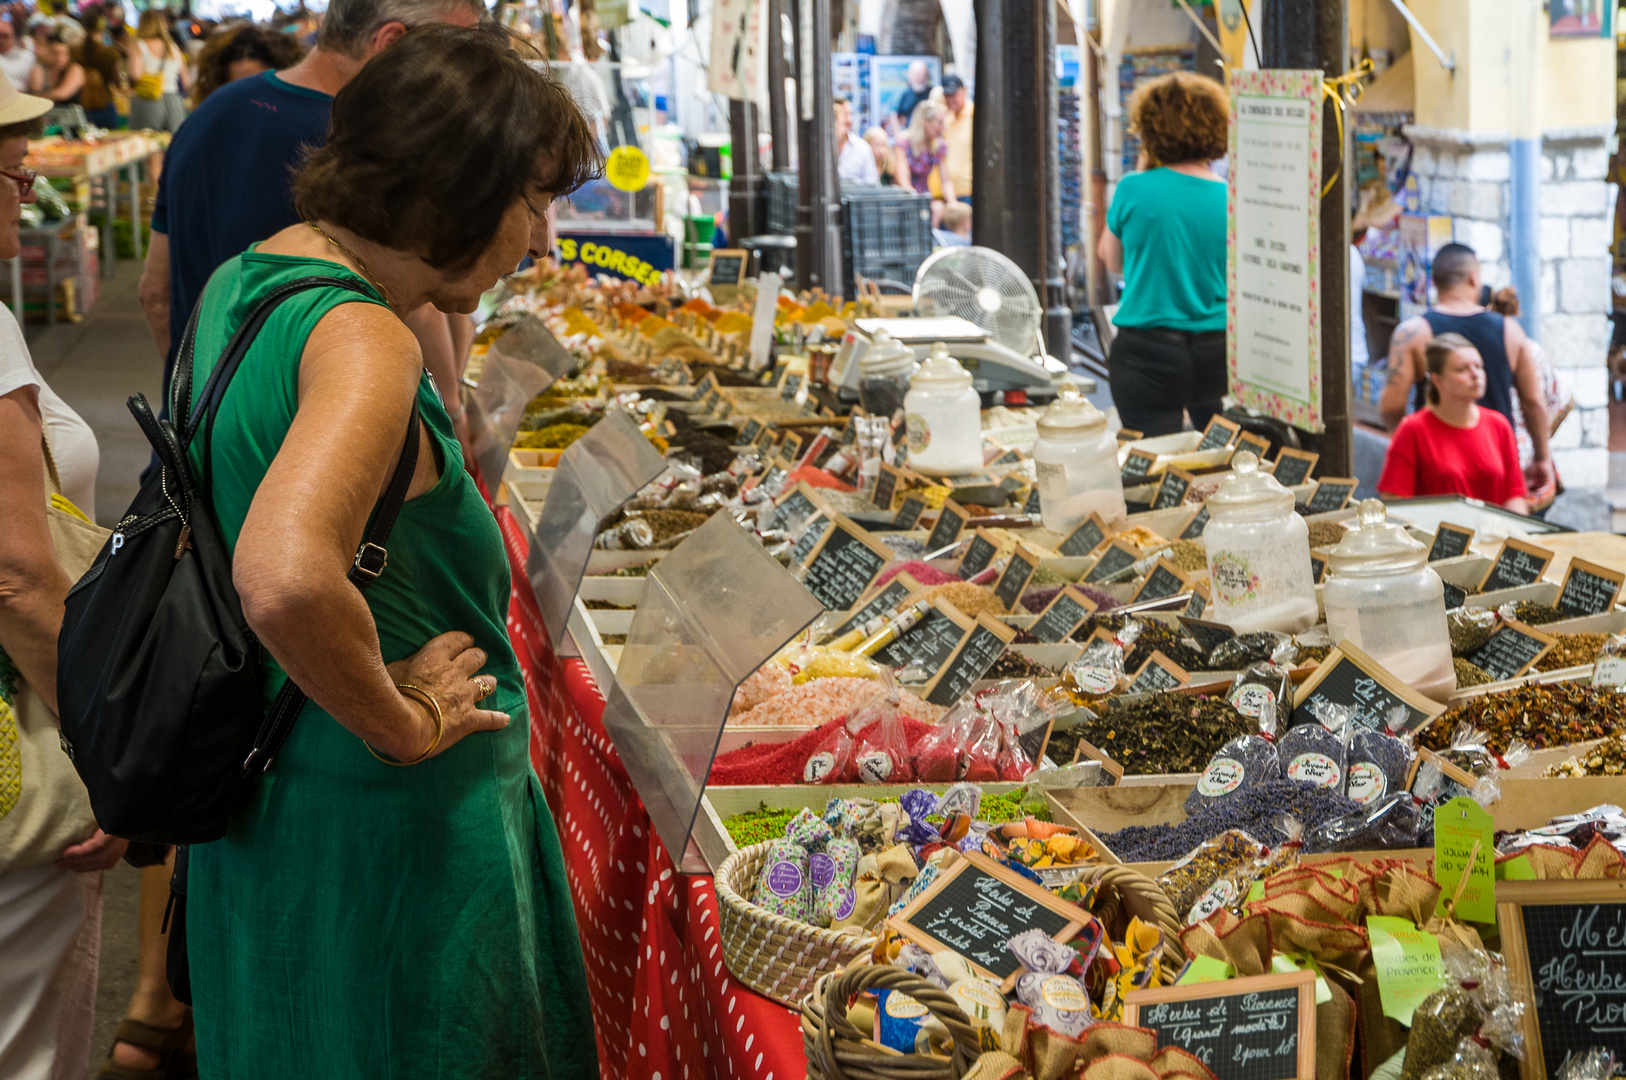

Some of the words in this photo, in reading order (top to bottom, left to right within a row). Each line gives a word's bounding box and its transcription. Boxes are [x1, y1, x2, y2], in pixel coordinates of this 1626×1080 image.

[1443, 848, 1486, 864] Prvence
[1441, 860, 1453, 872] de
[938, 906, 953, 918] 3
[1381, 953, 1418, 964] Herbes
[1422, 952, 1436, 962] de
[1386, 965, 1436, 977] Provence
[1206, 999, 1228, 1016] de
[1562, 992, 1626, 1024] Pro
